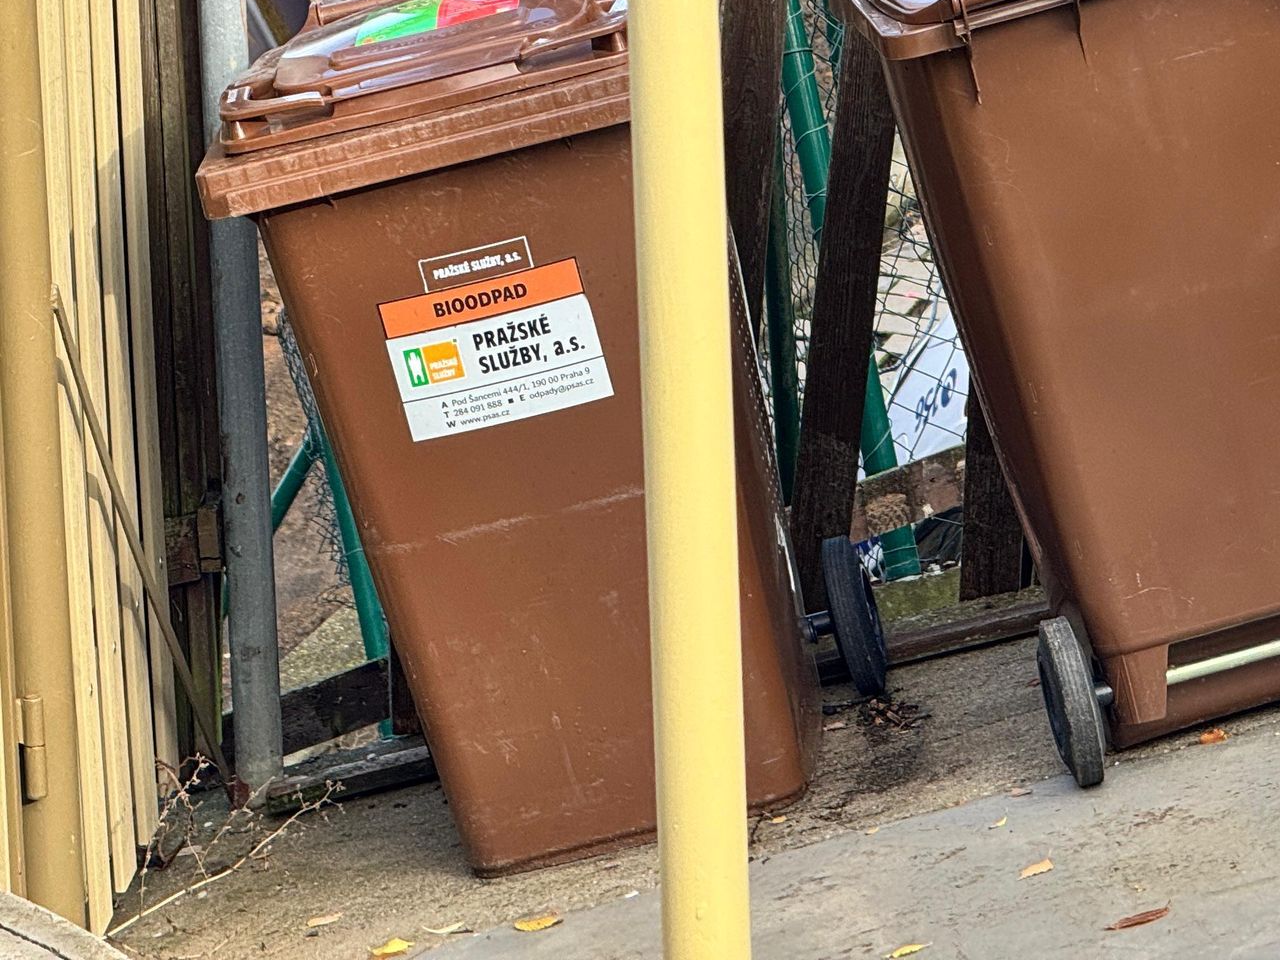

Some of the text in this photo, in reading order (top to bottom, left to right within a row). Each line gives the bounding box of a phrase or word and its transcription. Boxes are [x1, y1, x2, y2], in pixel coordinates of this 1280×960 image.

[432, 251, 522, 280] PRAŽSKÉ SLUŽBY, a.s.
[432, 283, 528, 318] BIOODPAD
[473, 313, 551, 351] PRAŽSKÉ
[479, 336, 586, 374] SLUŽBY, a.s.
[442, 401, 449, 409] A
[452, 397, 468, 406] Pod
[468, 388, 502, 403] Šancemi
[531, 378, 547, 389] 190
[548, 375, 559, 384] 00
[560, 370, 584, 381] Praha
[584, 366, 591, 375] 9
[453, 407, 469, 417] 284
[470, 404, 486, 413] 091
[486, 399, 503, 409] 888
[529, 378, 595, 400] odpady@psas.cz
[446, 409, 511, 428] W www.psas.cz
